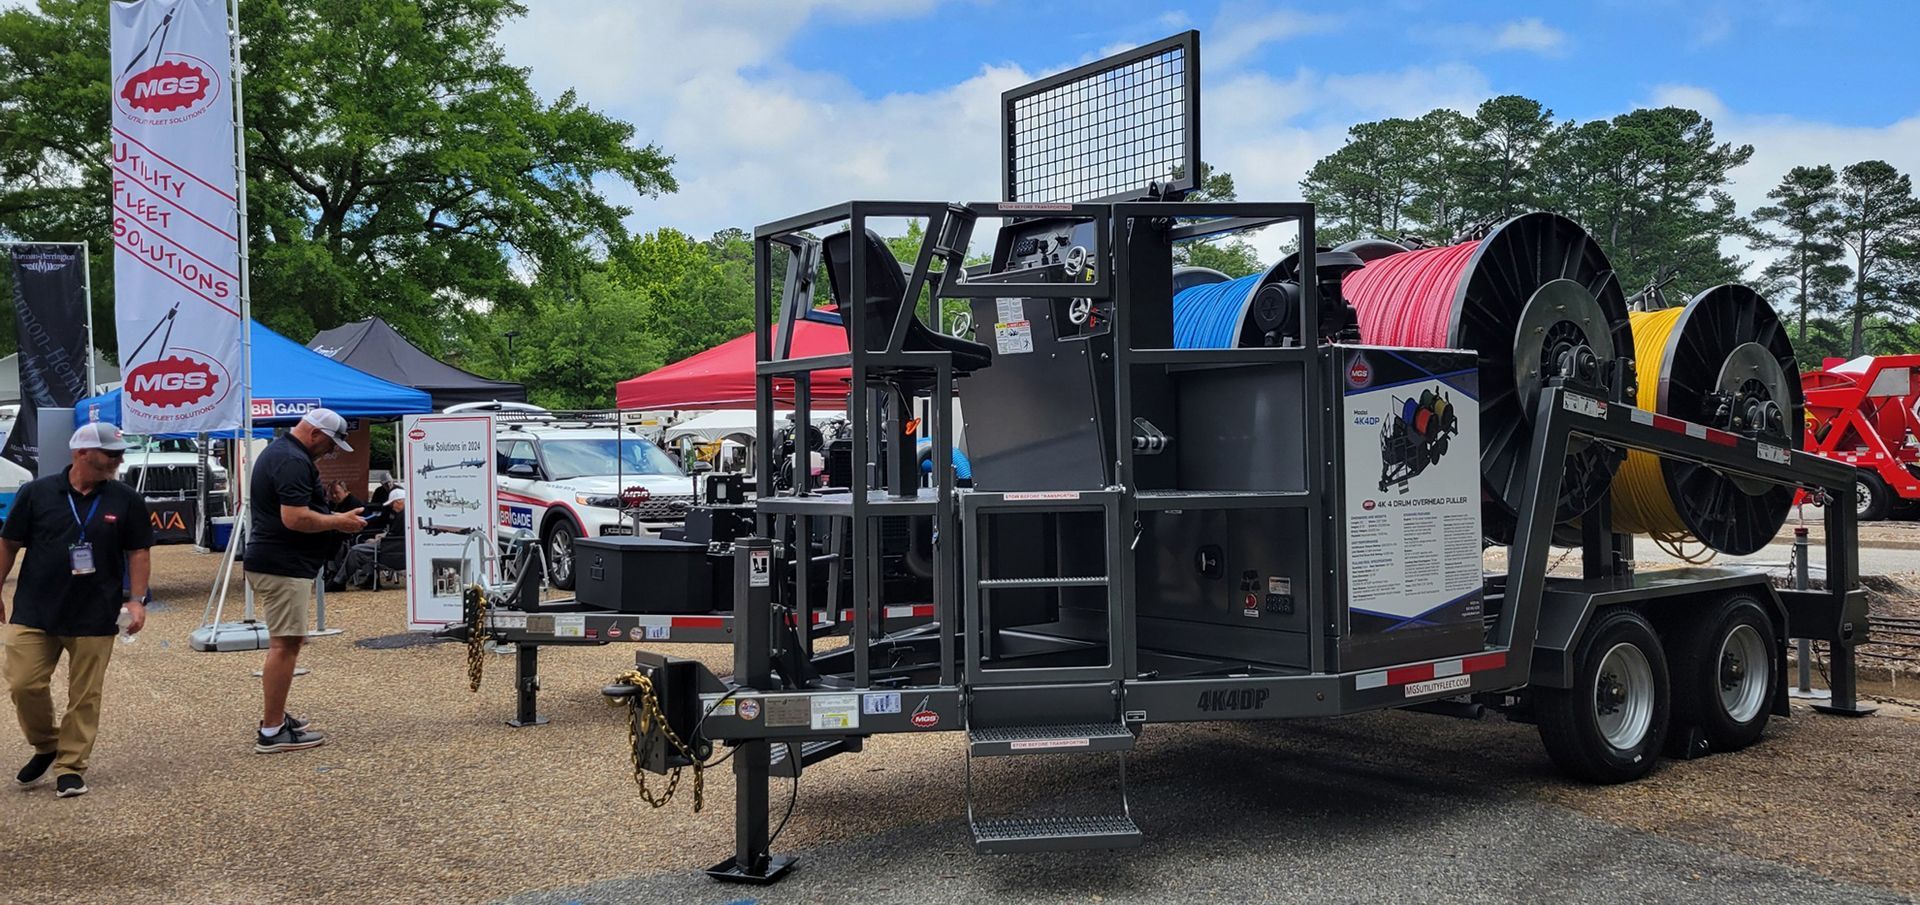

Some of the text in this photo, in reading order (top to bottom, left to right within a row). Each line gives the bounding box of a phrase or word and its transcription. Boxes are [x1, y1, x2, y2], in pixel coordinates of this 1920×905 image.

[134, 76, 199, 99] MGS
[168, 106, 207, 125] SOLUTIONS
[113, 142, 186, 198] UTILITY
[113, 180, 171, 228] FLEET
[113, 217, 229, 298] SOLUTIONS
[134, 371, 208, 392] MGS
[130, 407, 152, 420] UTILITY
[175, 404, 216, 420] SOLUTIONS
[423, 441, 481, 452] New Solutions in 2024
[1393, 499, 1412, 507] DRUM
[1412, 498, 1445, 506] OVERHEAD
[500, 510, 532, 527] BRIGADE
[1405, 677, 1470, 696] MGSUTILITYFLEET.COM
[1197, 687, 1270, 711] 4K4DP
[1049, 739, 1088, 747] TRANSPORTING
